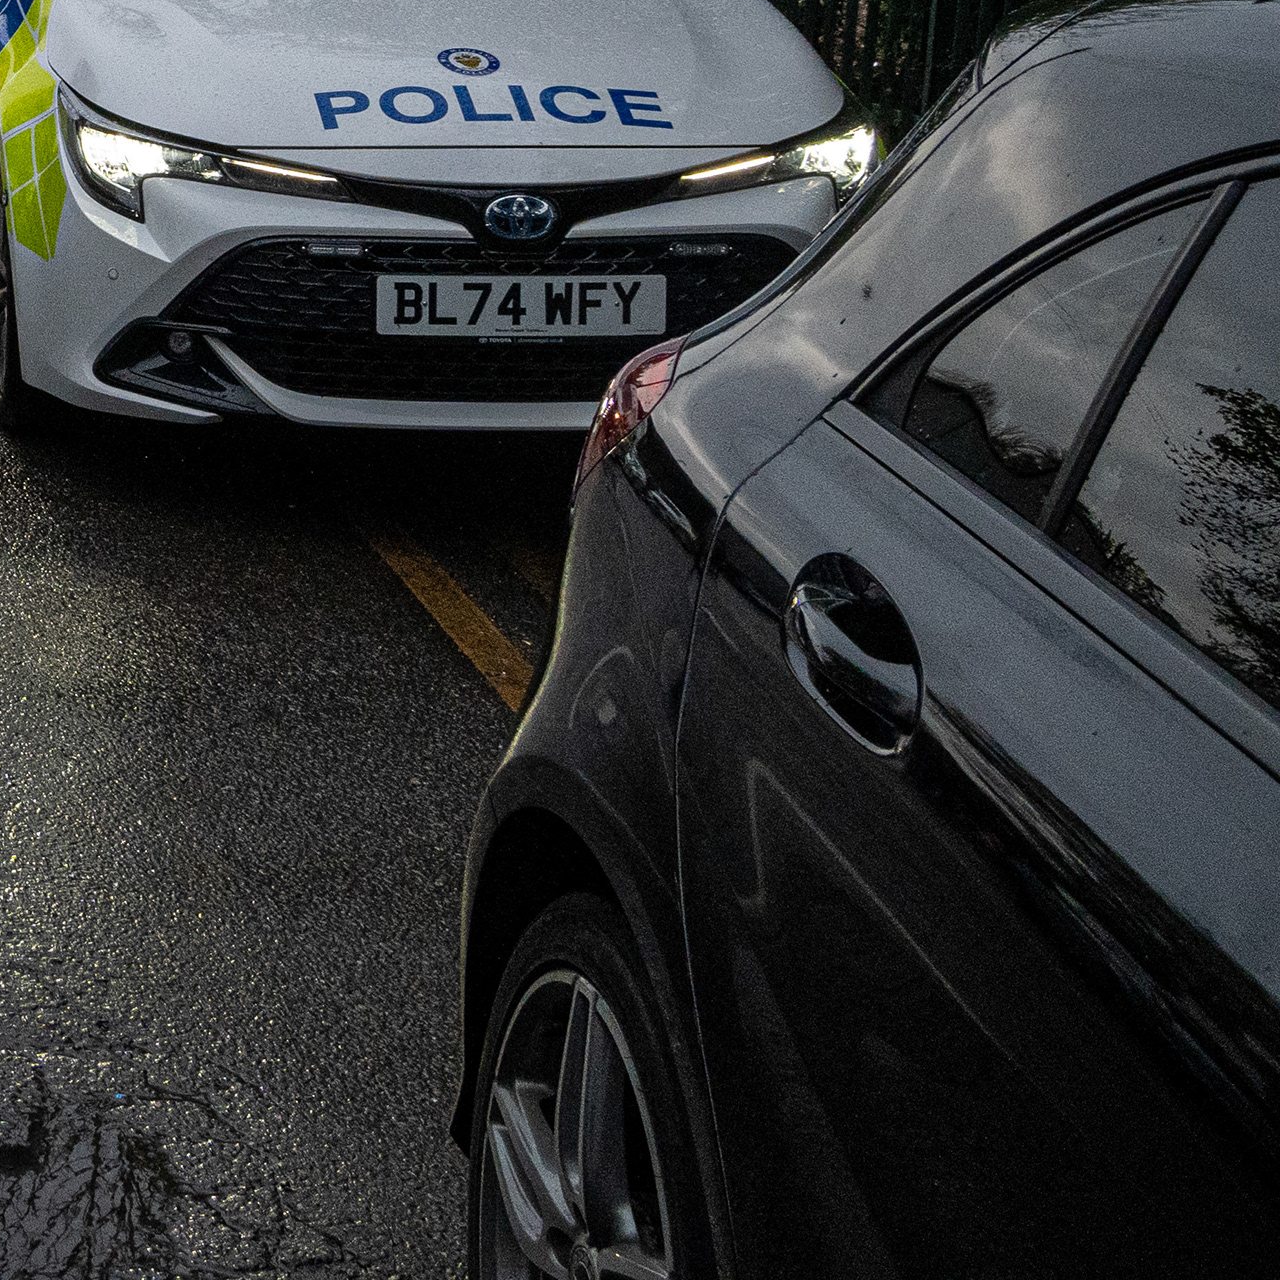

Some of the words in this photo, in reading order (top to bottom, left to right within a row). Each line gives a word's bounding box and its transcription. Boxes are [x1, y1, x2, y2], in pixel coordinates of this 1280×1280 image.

[314, 85, 674, 131] POLICE
[393, 282, 527, 326] BL74
[544, 281, 641, 326] WFY
